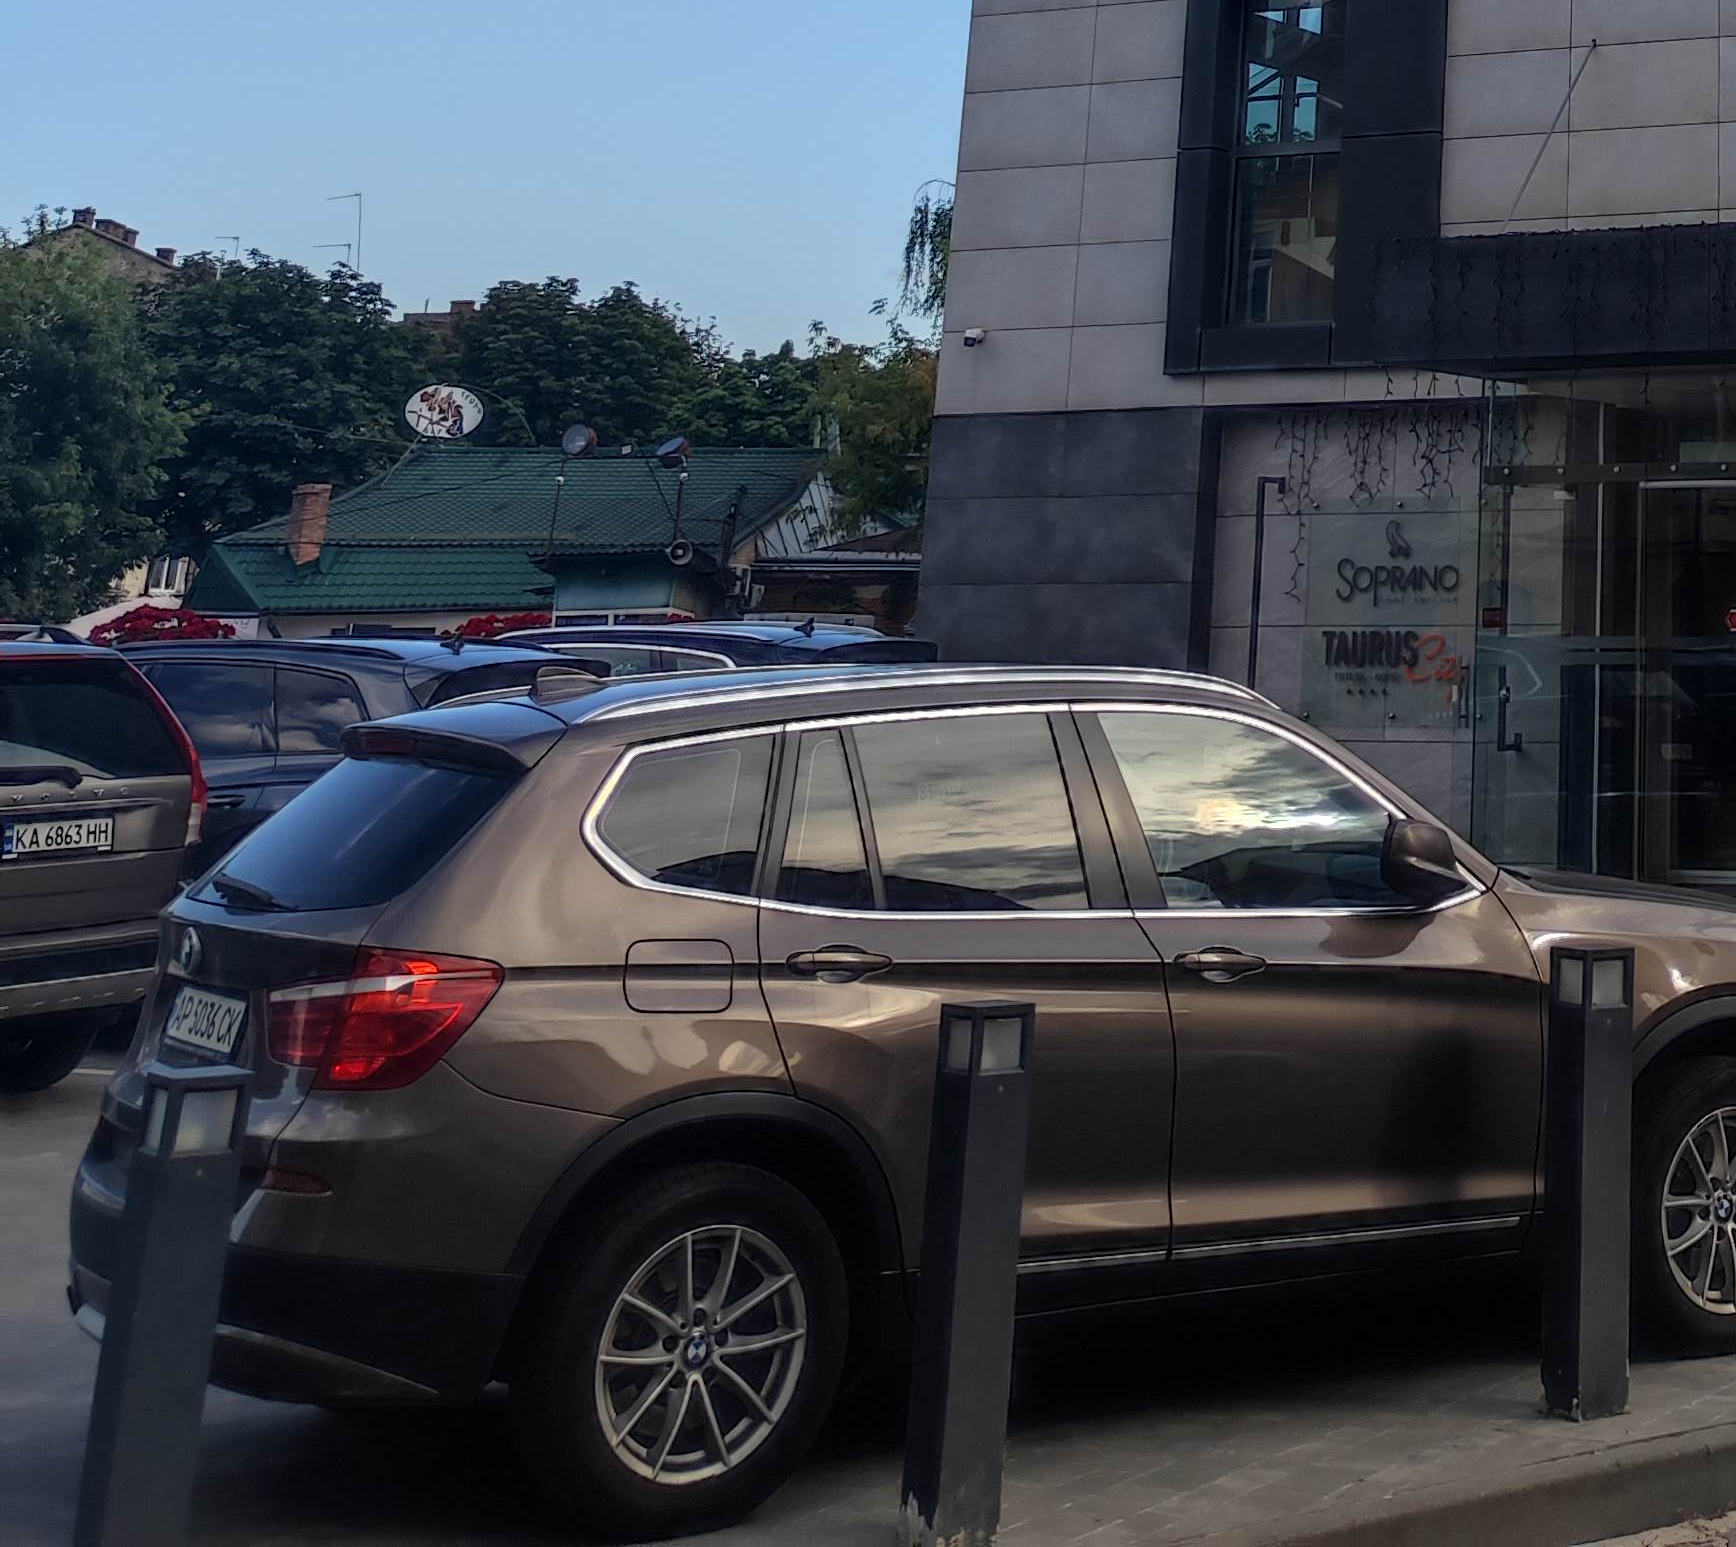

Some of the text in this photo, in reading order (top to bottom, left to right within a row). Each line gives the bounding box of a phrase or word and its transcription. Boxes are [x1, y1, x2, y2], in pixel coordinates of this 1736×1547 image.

[1322, 630, 1419, 668] TAURUS
[15, 822, 109, 849] KA 6863 HH
